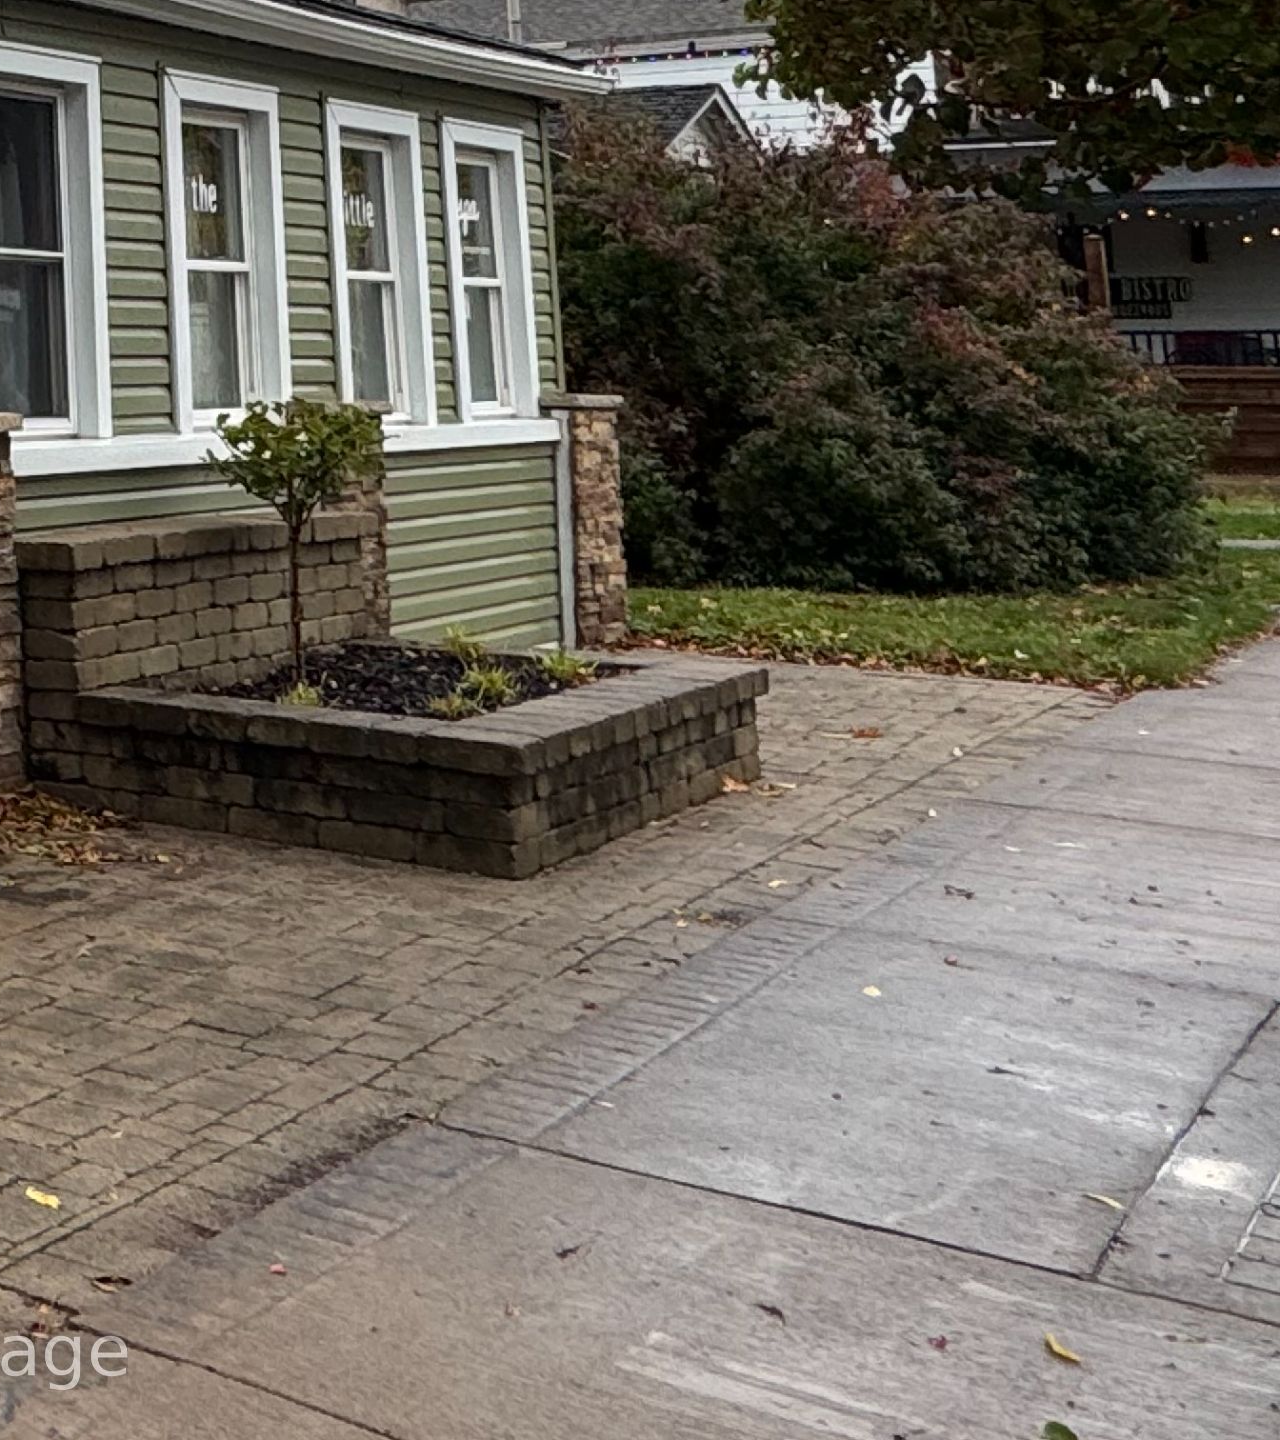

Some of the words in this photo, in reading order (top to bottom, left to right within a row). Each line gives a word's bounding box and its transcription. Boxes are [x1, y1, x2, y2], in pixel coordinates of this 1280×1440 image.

[191, 173, 217, 214] the
[343, 190, 375, 228] ittle
[1120, 277, 1192, 302] BISTRO
